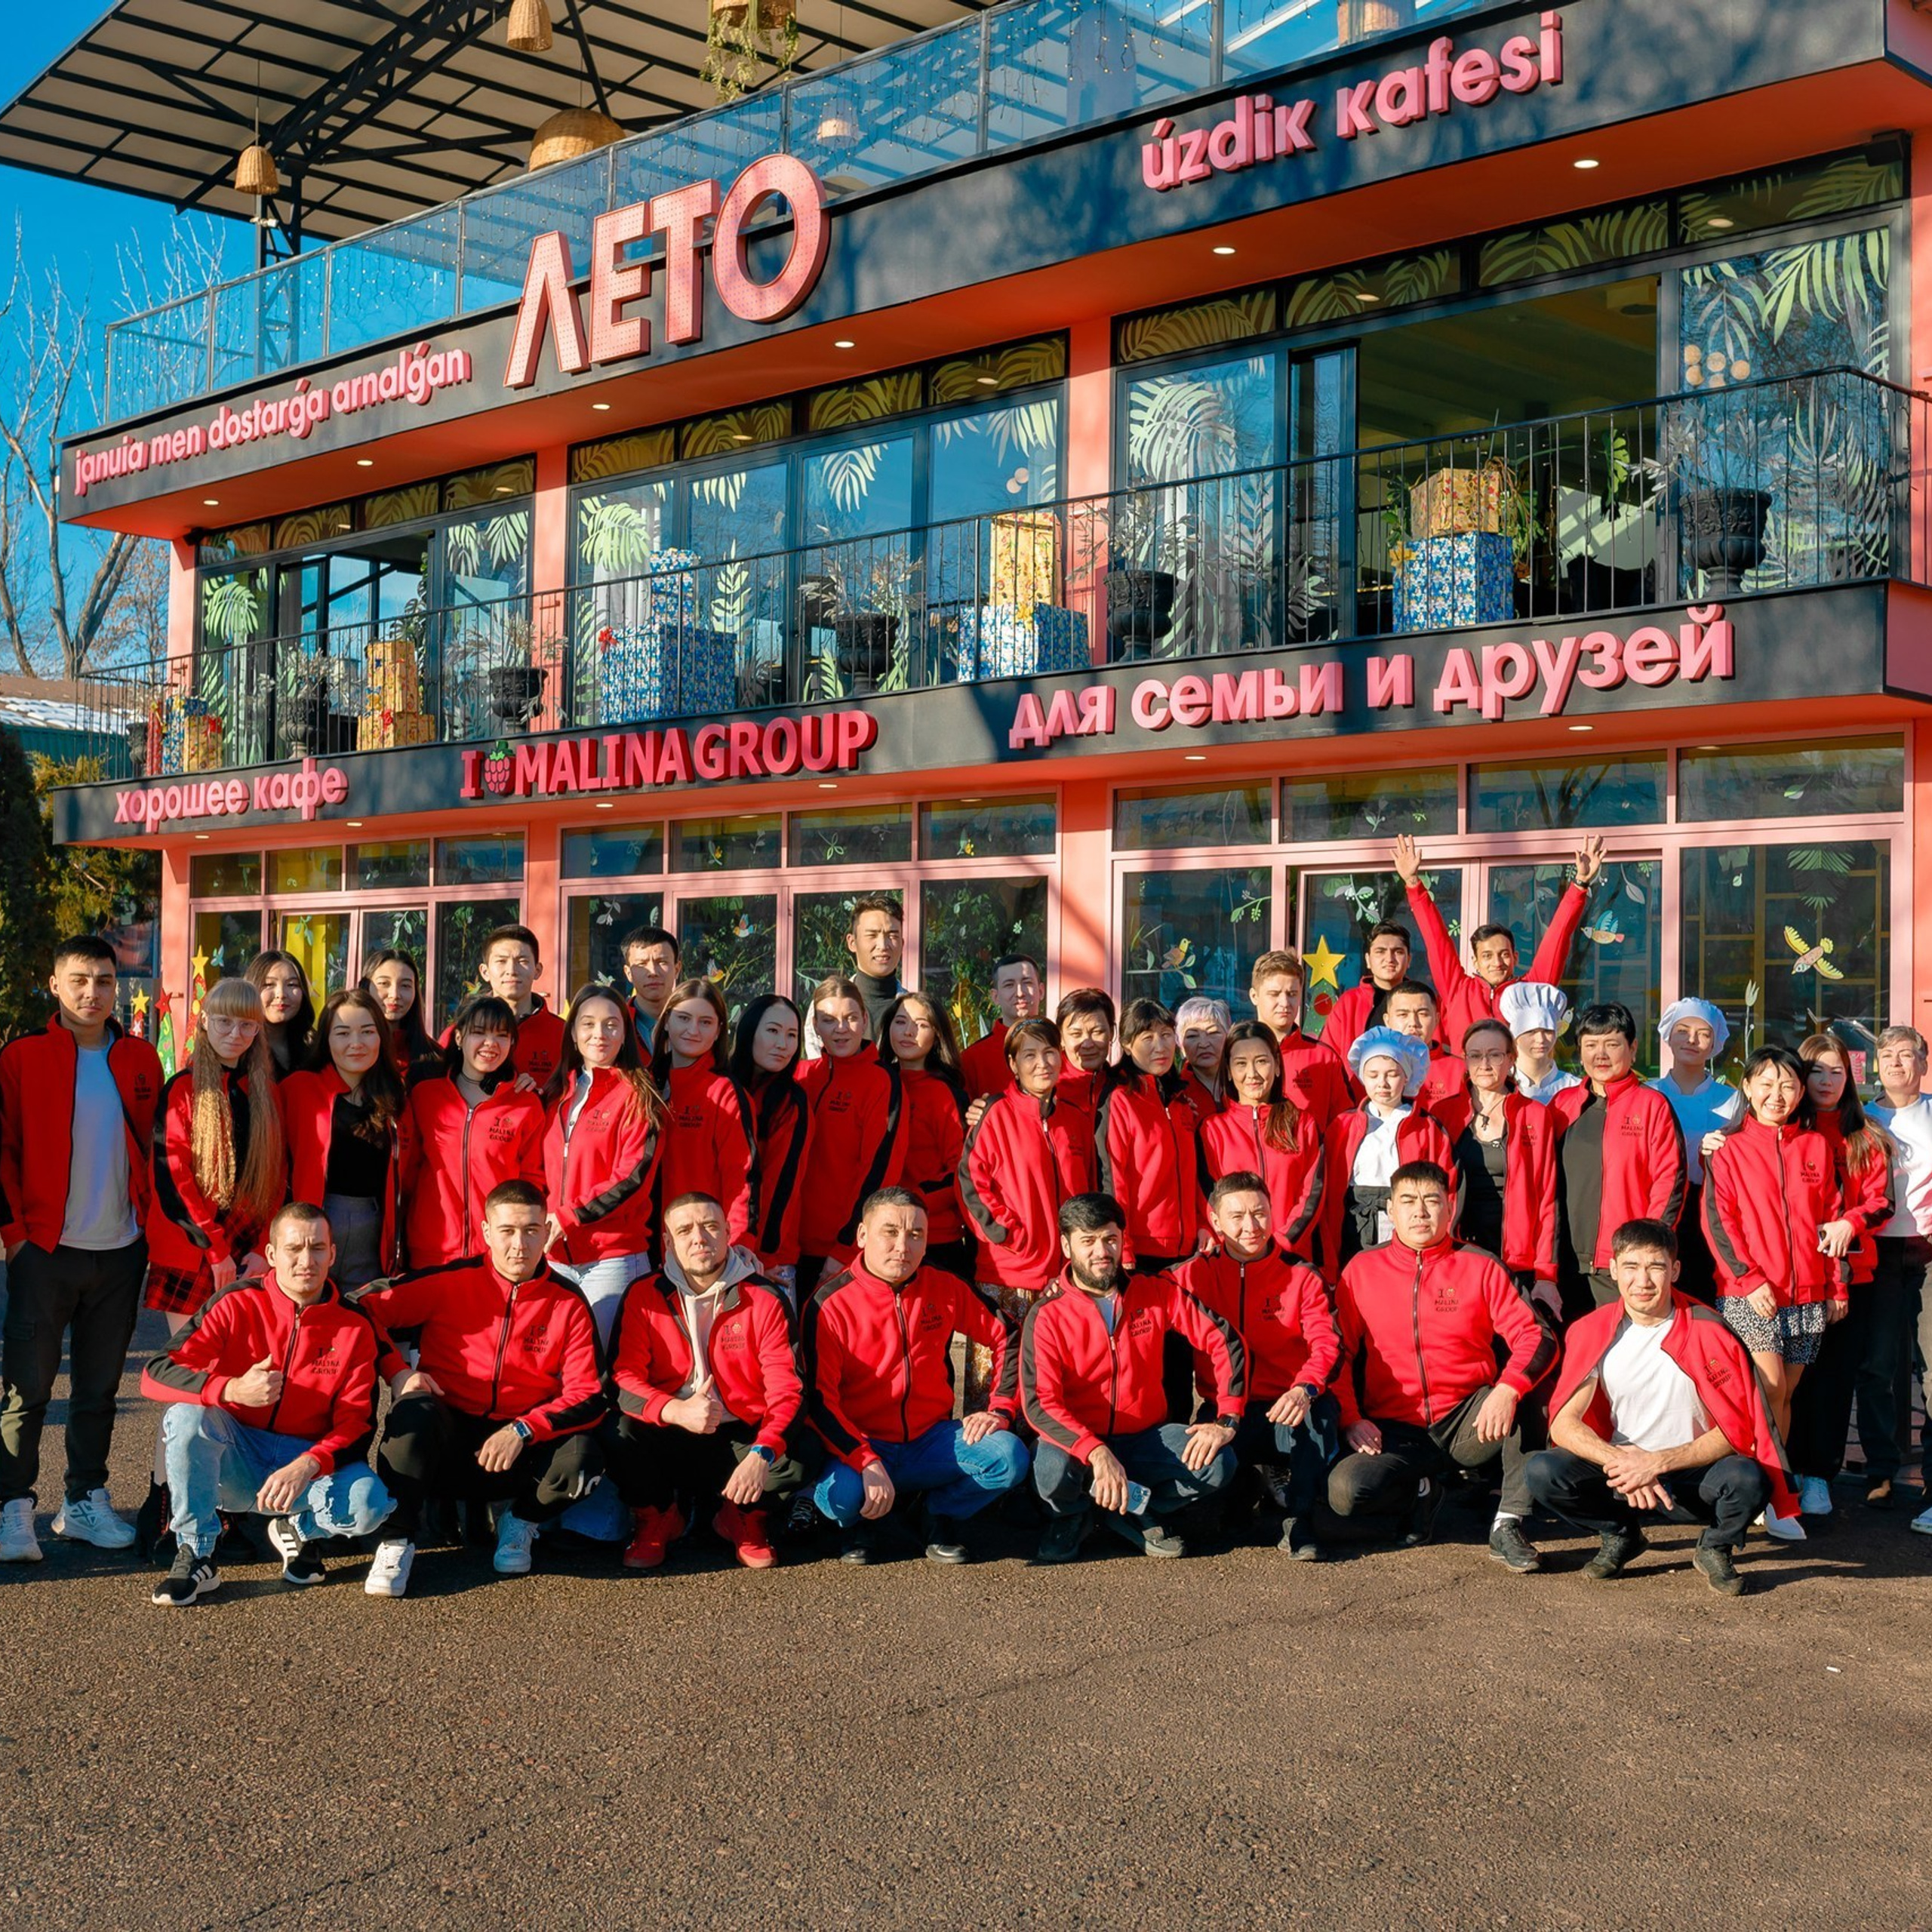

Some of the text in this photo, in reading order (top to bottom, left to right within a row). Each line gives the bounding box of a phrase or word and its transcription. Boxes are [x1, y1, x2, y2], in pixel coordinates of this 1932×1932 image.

[1141, 11, 1563, 191] úzdik kafesi
[503, 153, 832, 389] ЛЕТО
[74, 435, 149, 497] januia
[150, 424, 208, 466] men
[1008, 603, 1734, 749] для семьи и друзей
[114, 757, 349, 834] хорошее кафе
